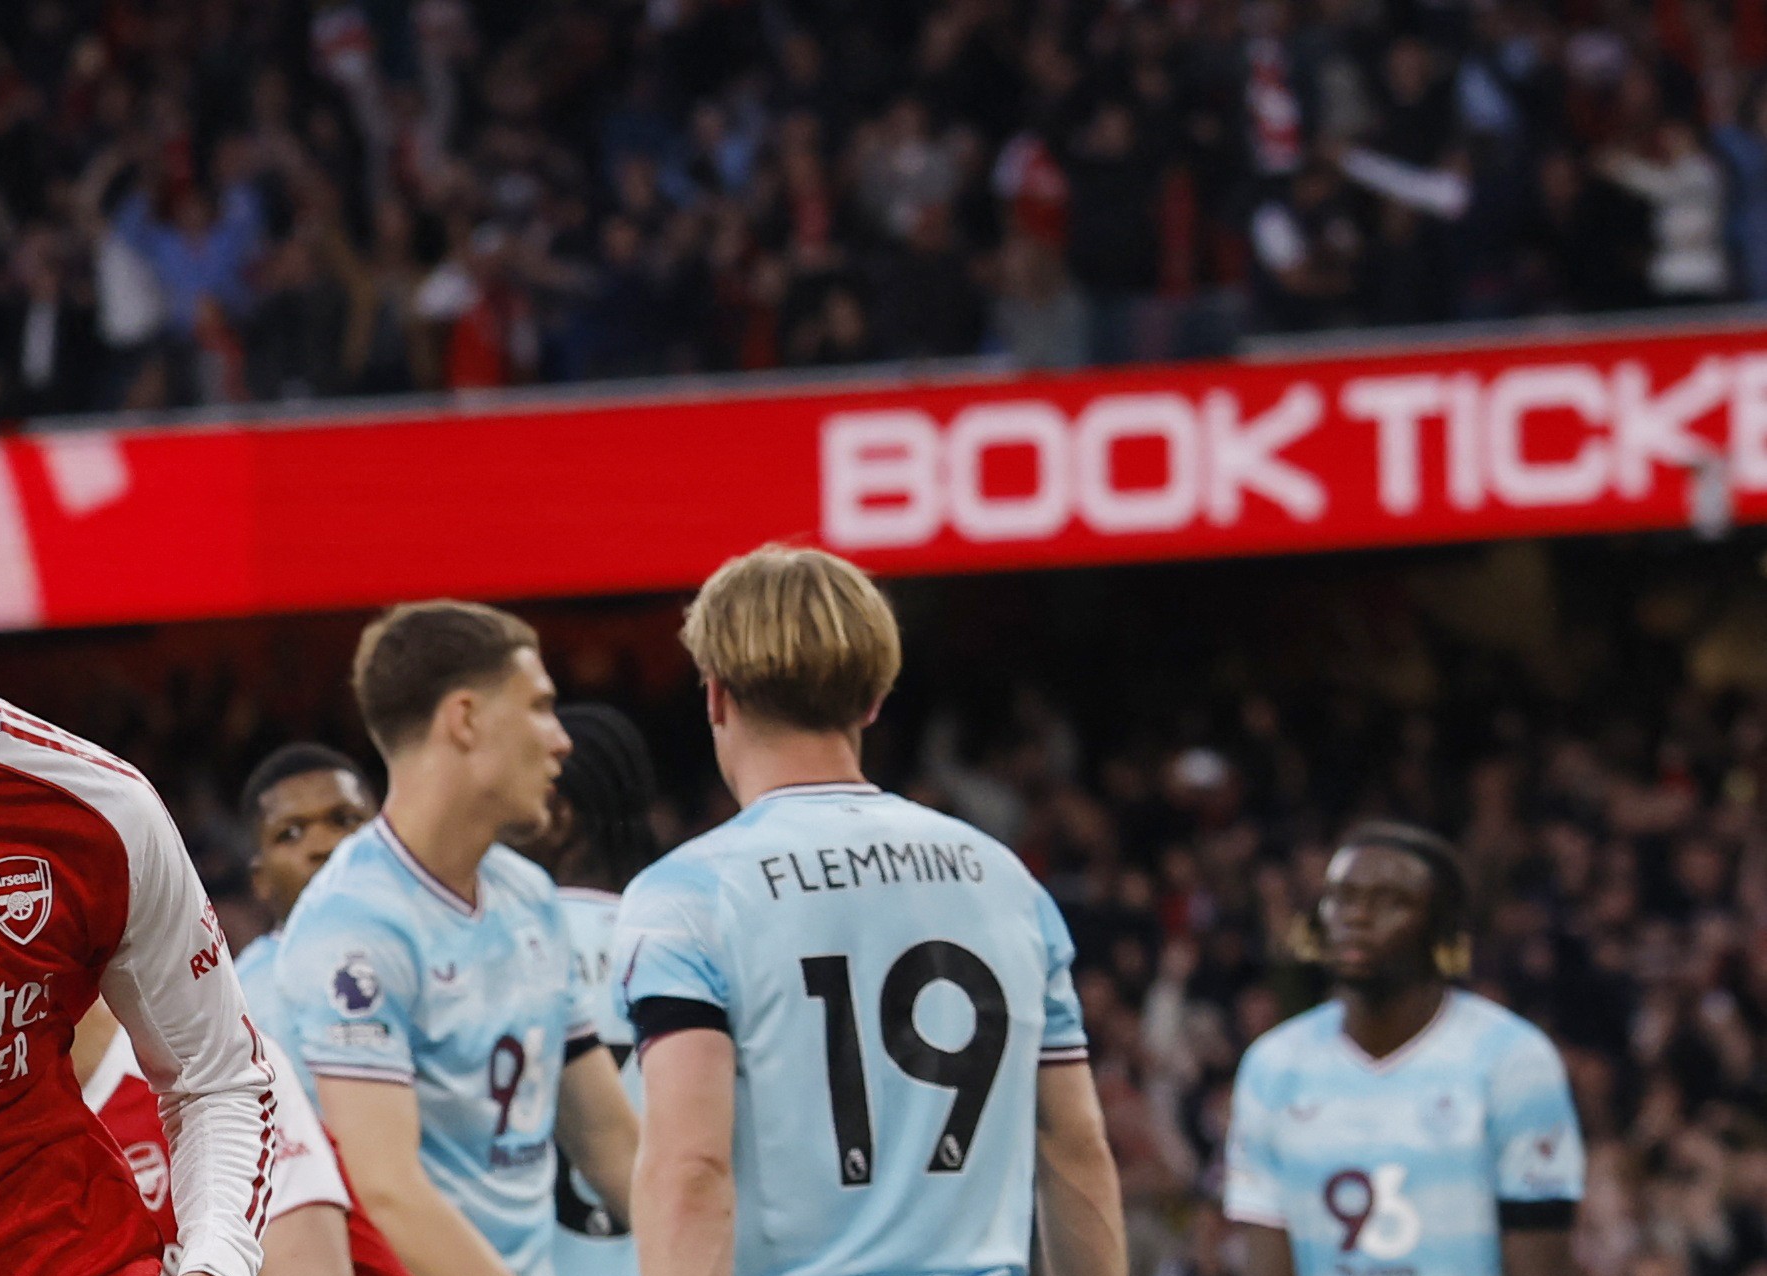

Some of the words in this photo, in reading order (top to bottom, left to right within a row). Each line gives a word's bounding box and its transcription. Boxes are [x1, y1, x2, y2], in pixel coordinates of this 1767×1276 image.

[821, 390, 1326, 550] BOOK
[760, 842, 984, 900] FLEMMING
[800, 938, 1011, 1188] 19
